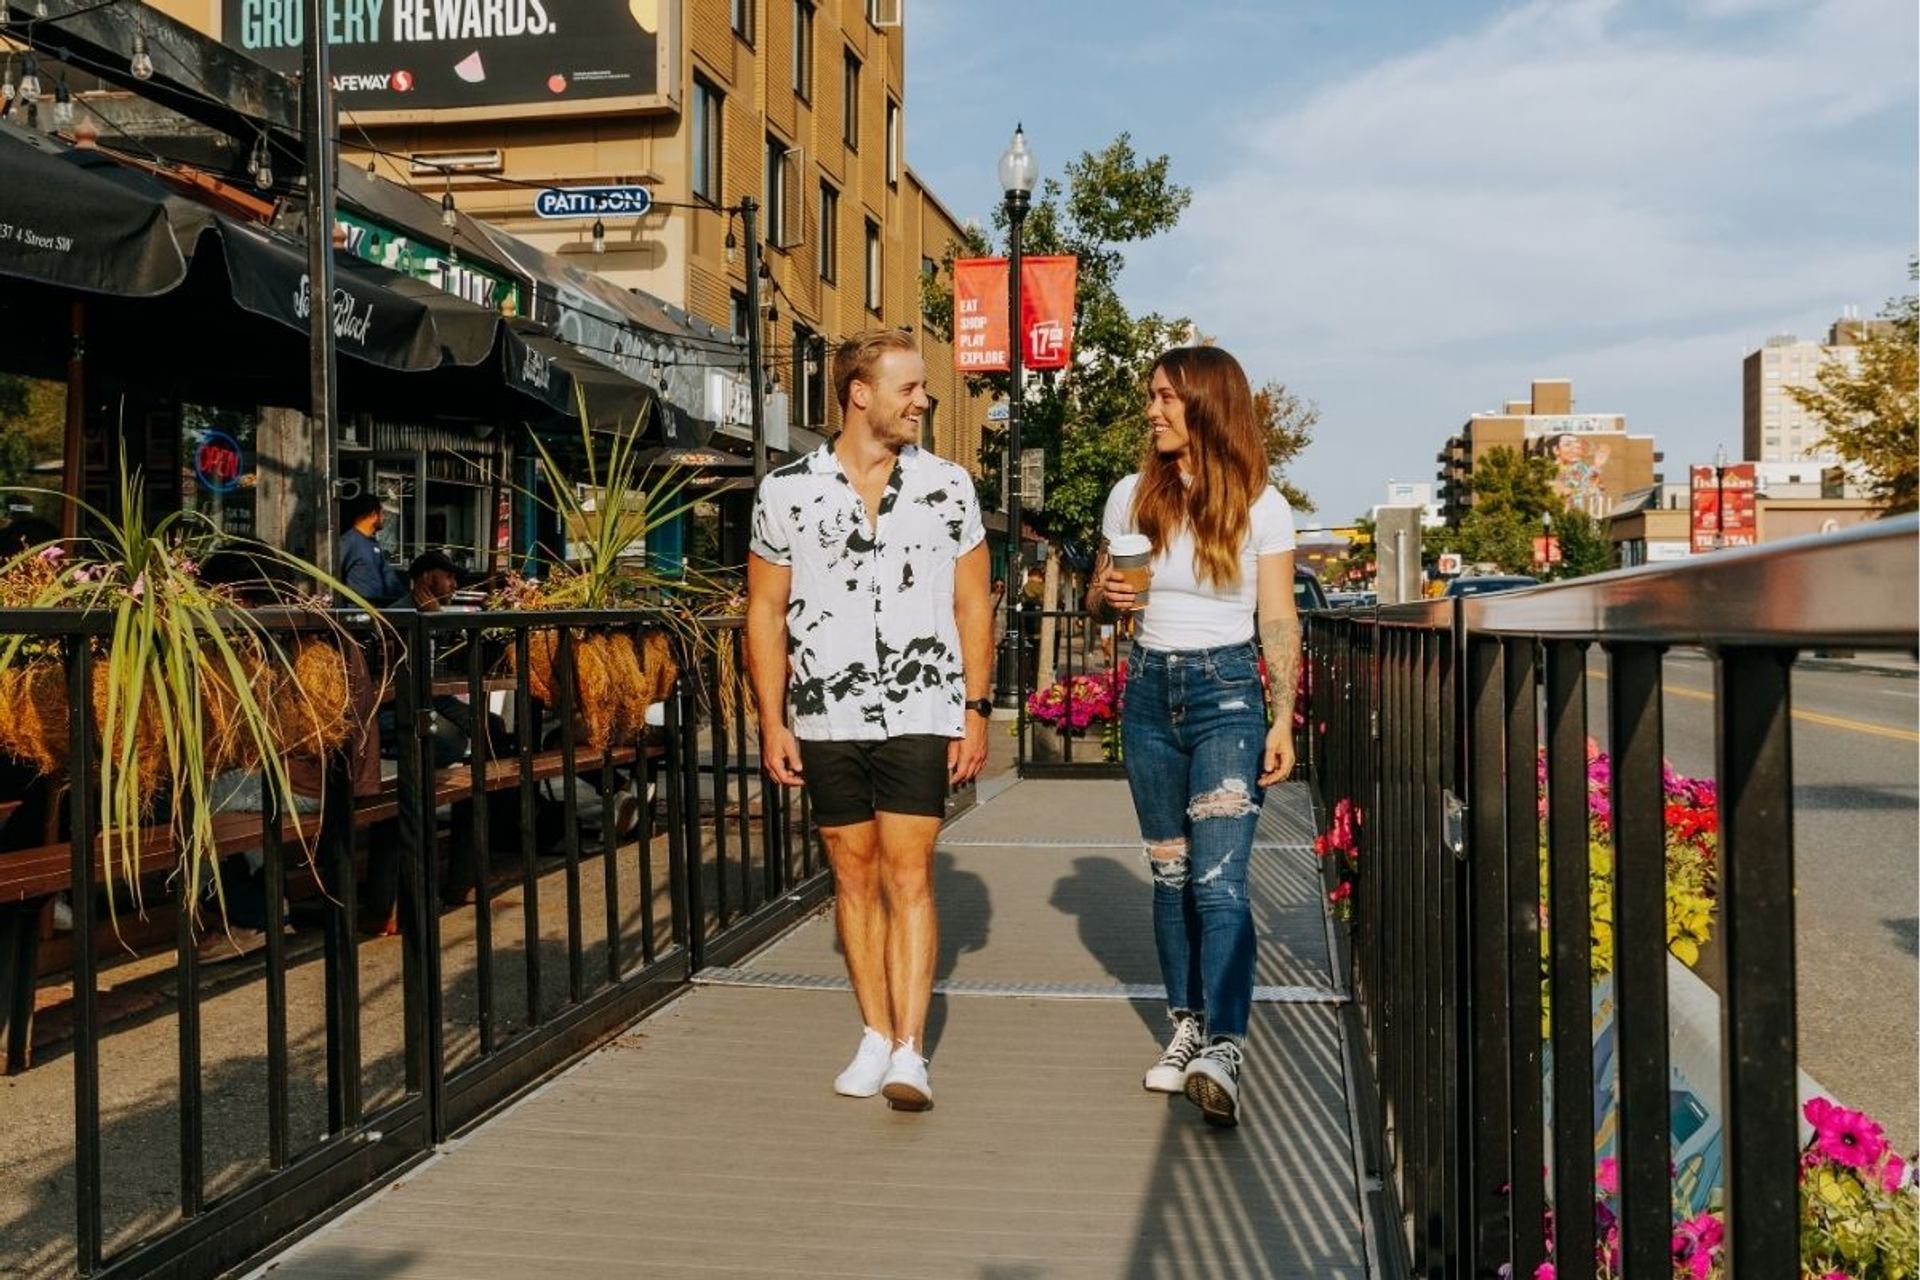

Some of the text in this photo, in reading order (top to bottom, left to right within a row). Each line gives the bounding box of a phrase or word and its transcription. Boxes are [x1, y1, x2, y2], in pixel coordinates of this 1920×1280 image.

[241, 0, 557, 49] GROERY REWARDS.
[333, 74, 391, 92] AFEWAY
[544, 191, 642, 212] PATTISON
[0, 223, 13, 240] 37
[24, 229, 55, 250] Street
[960, 299, 978, 312] EAT
[960, 316, 987, 329] SHOP
[960, 334, 986, 347] PLAY
[960, 350, 1006, 366] EXPLORE
[199, 443, 239, 480] OPEN
